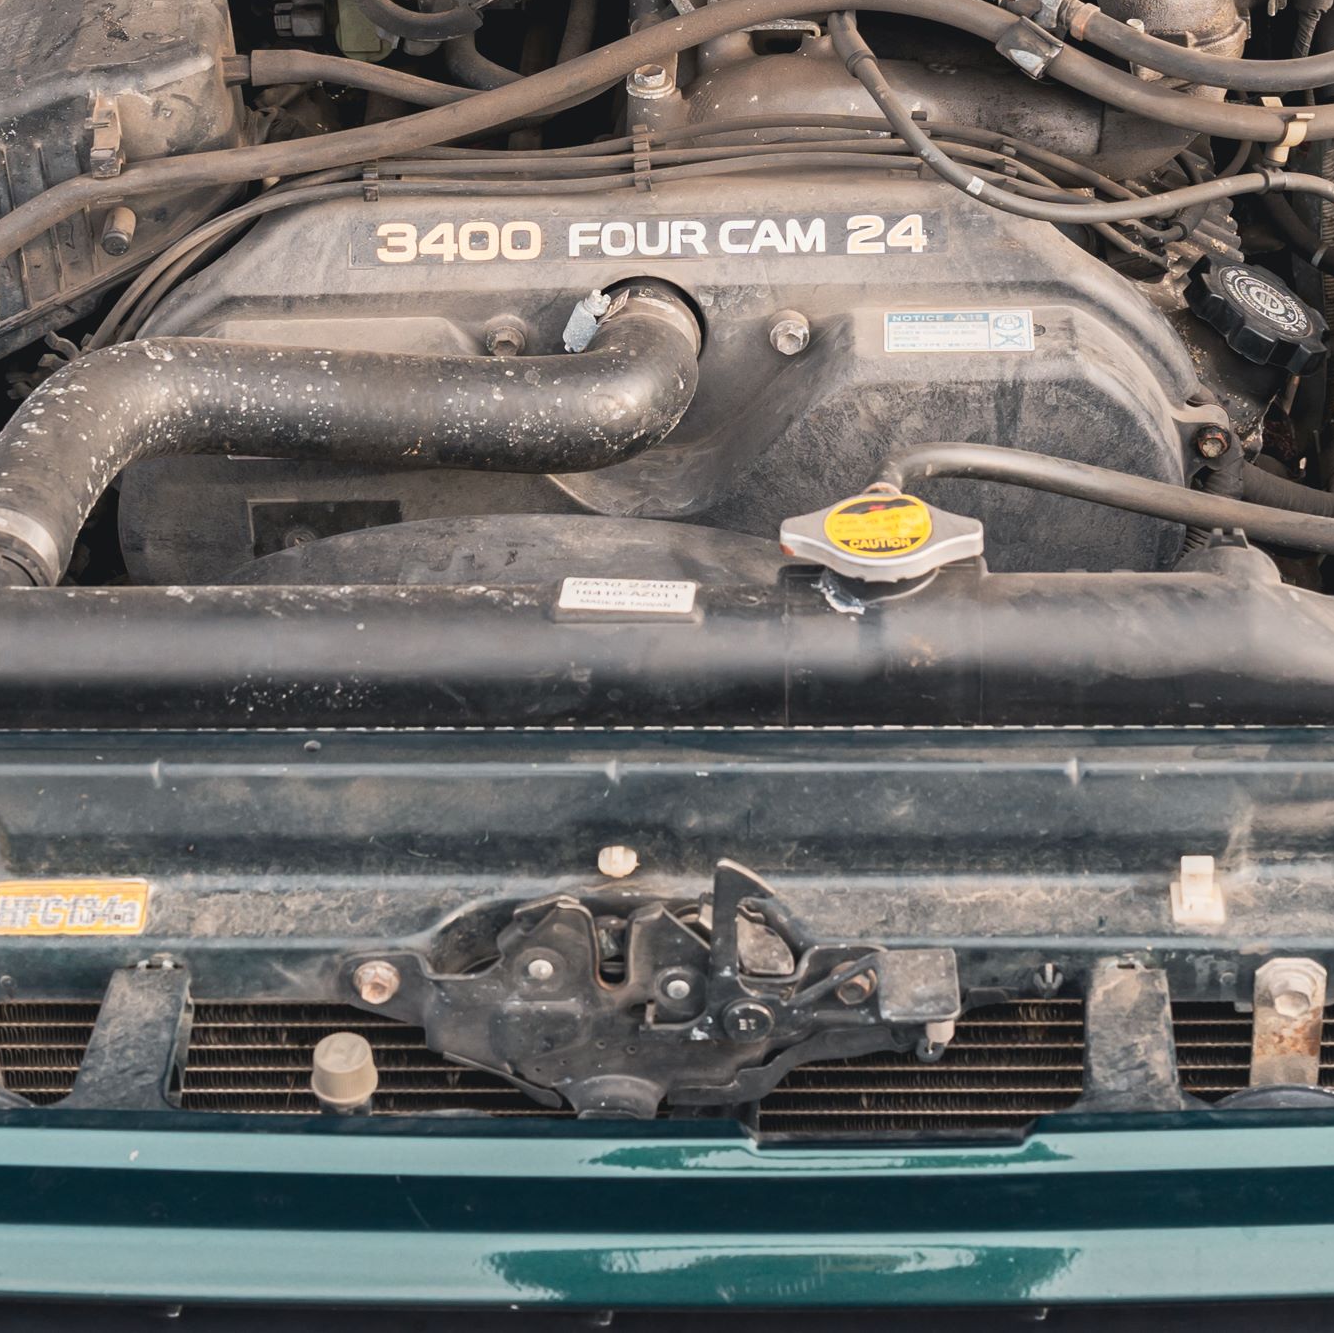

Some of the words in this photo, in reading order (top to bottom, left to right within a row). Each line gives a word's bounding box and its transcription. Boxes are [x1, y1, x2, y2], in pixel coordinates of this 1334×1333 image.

[376, 222, 542, 263] 3400
[568, 219, 710, 258] FOUR
[718, 217, 827, 255] CAM
[846, 214, 929, 255] 24
[849, 538, 912, 549] CAUTION
